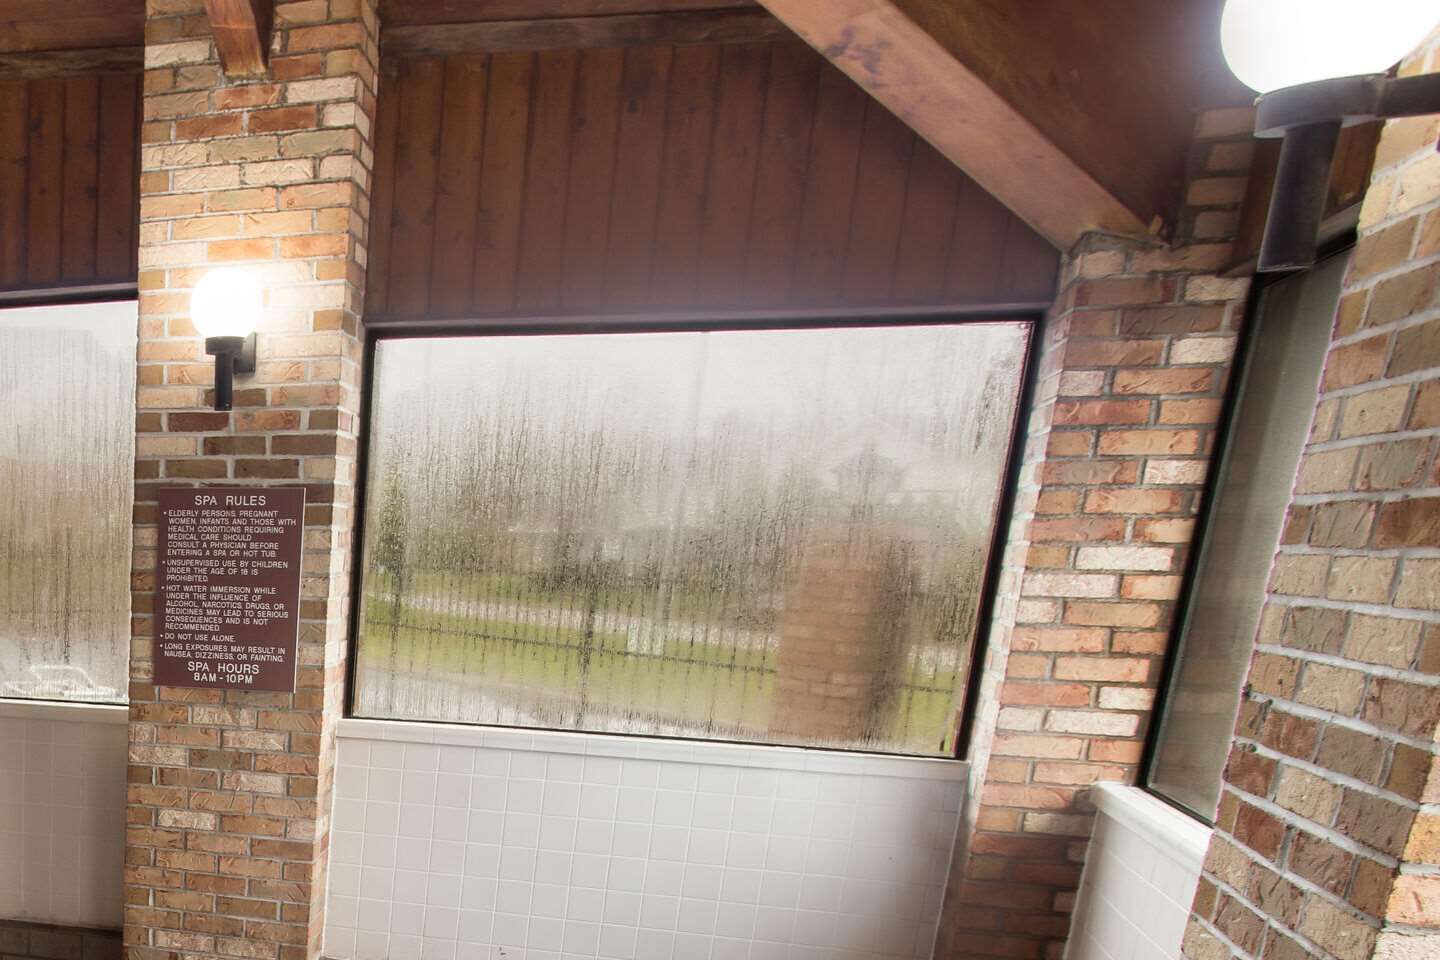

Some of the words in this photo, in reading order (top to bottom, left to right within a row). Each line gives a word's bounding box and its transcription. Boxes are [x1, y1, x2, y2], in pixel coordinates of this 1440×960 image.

[195, 496, 217, 505] SPA
[226, 496, 266, 506] RULES
[165, 615, 223, 624] CONSEQUENCES
[186, 644, 227, 652] EXPOSURES
[248, 646, 275, 654] RESULT
[278, 647, 285, 655] IN
[187, 661, 210, 672] SPA
[217, 663, 260, 674] HOURS
